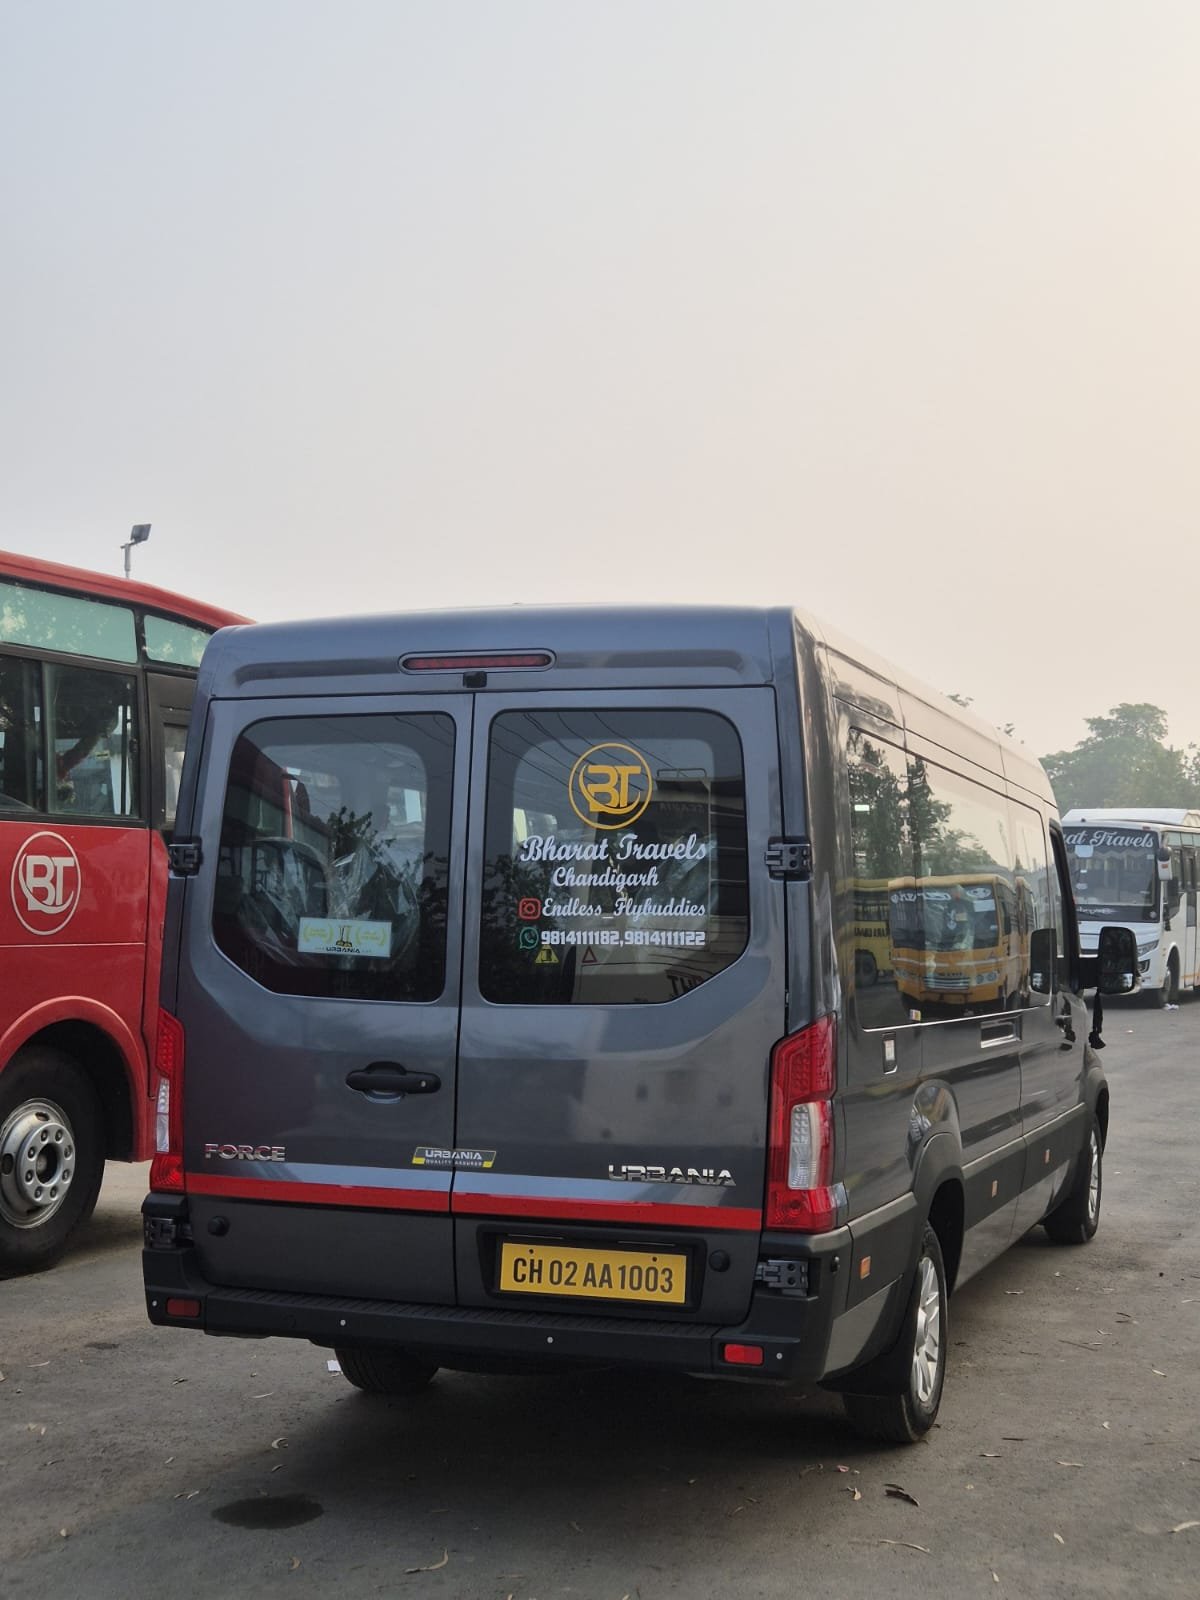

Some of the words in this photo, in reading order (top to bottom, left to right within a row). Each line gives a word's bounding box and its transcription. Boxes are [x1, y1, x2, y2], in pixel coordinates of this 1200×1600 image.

[579, 764, 642, 815] BT
[520, 835, 609, 862] Bharat
[616, 833, 708, 861] Travels
[1089, 830, 1154, 848] Travels
[18, 852, 75, 915] BT
[552, 866, 660, 892] Chandigarh
[541, 897, 706, 922] Endless_Flybuddies
[204, 1143, 286, 1162] FORCE
[425, 1149, 482, 1160] URBANIA
[607, 1164, 737, 1187] URBANIA
[513, 1257, 543, 1284] CH
[549, 1259, 578, 1287] 02
[582, 1262, 613, 1289] AA
[617, 1264, 673, 1294] 1003
